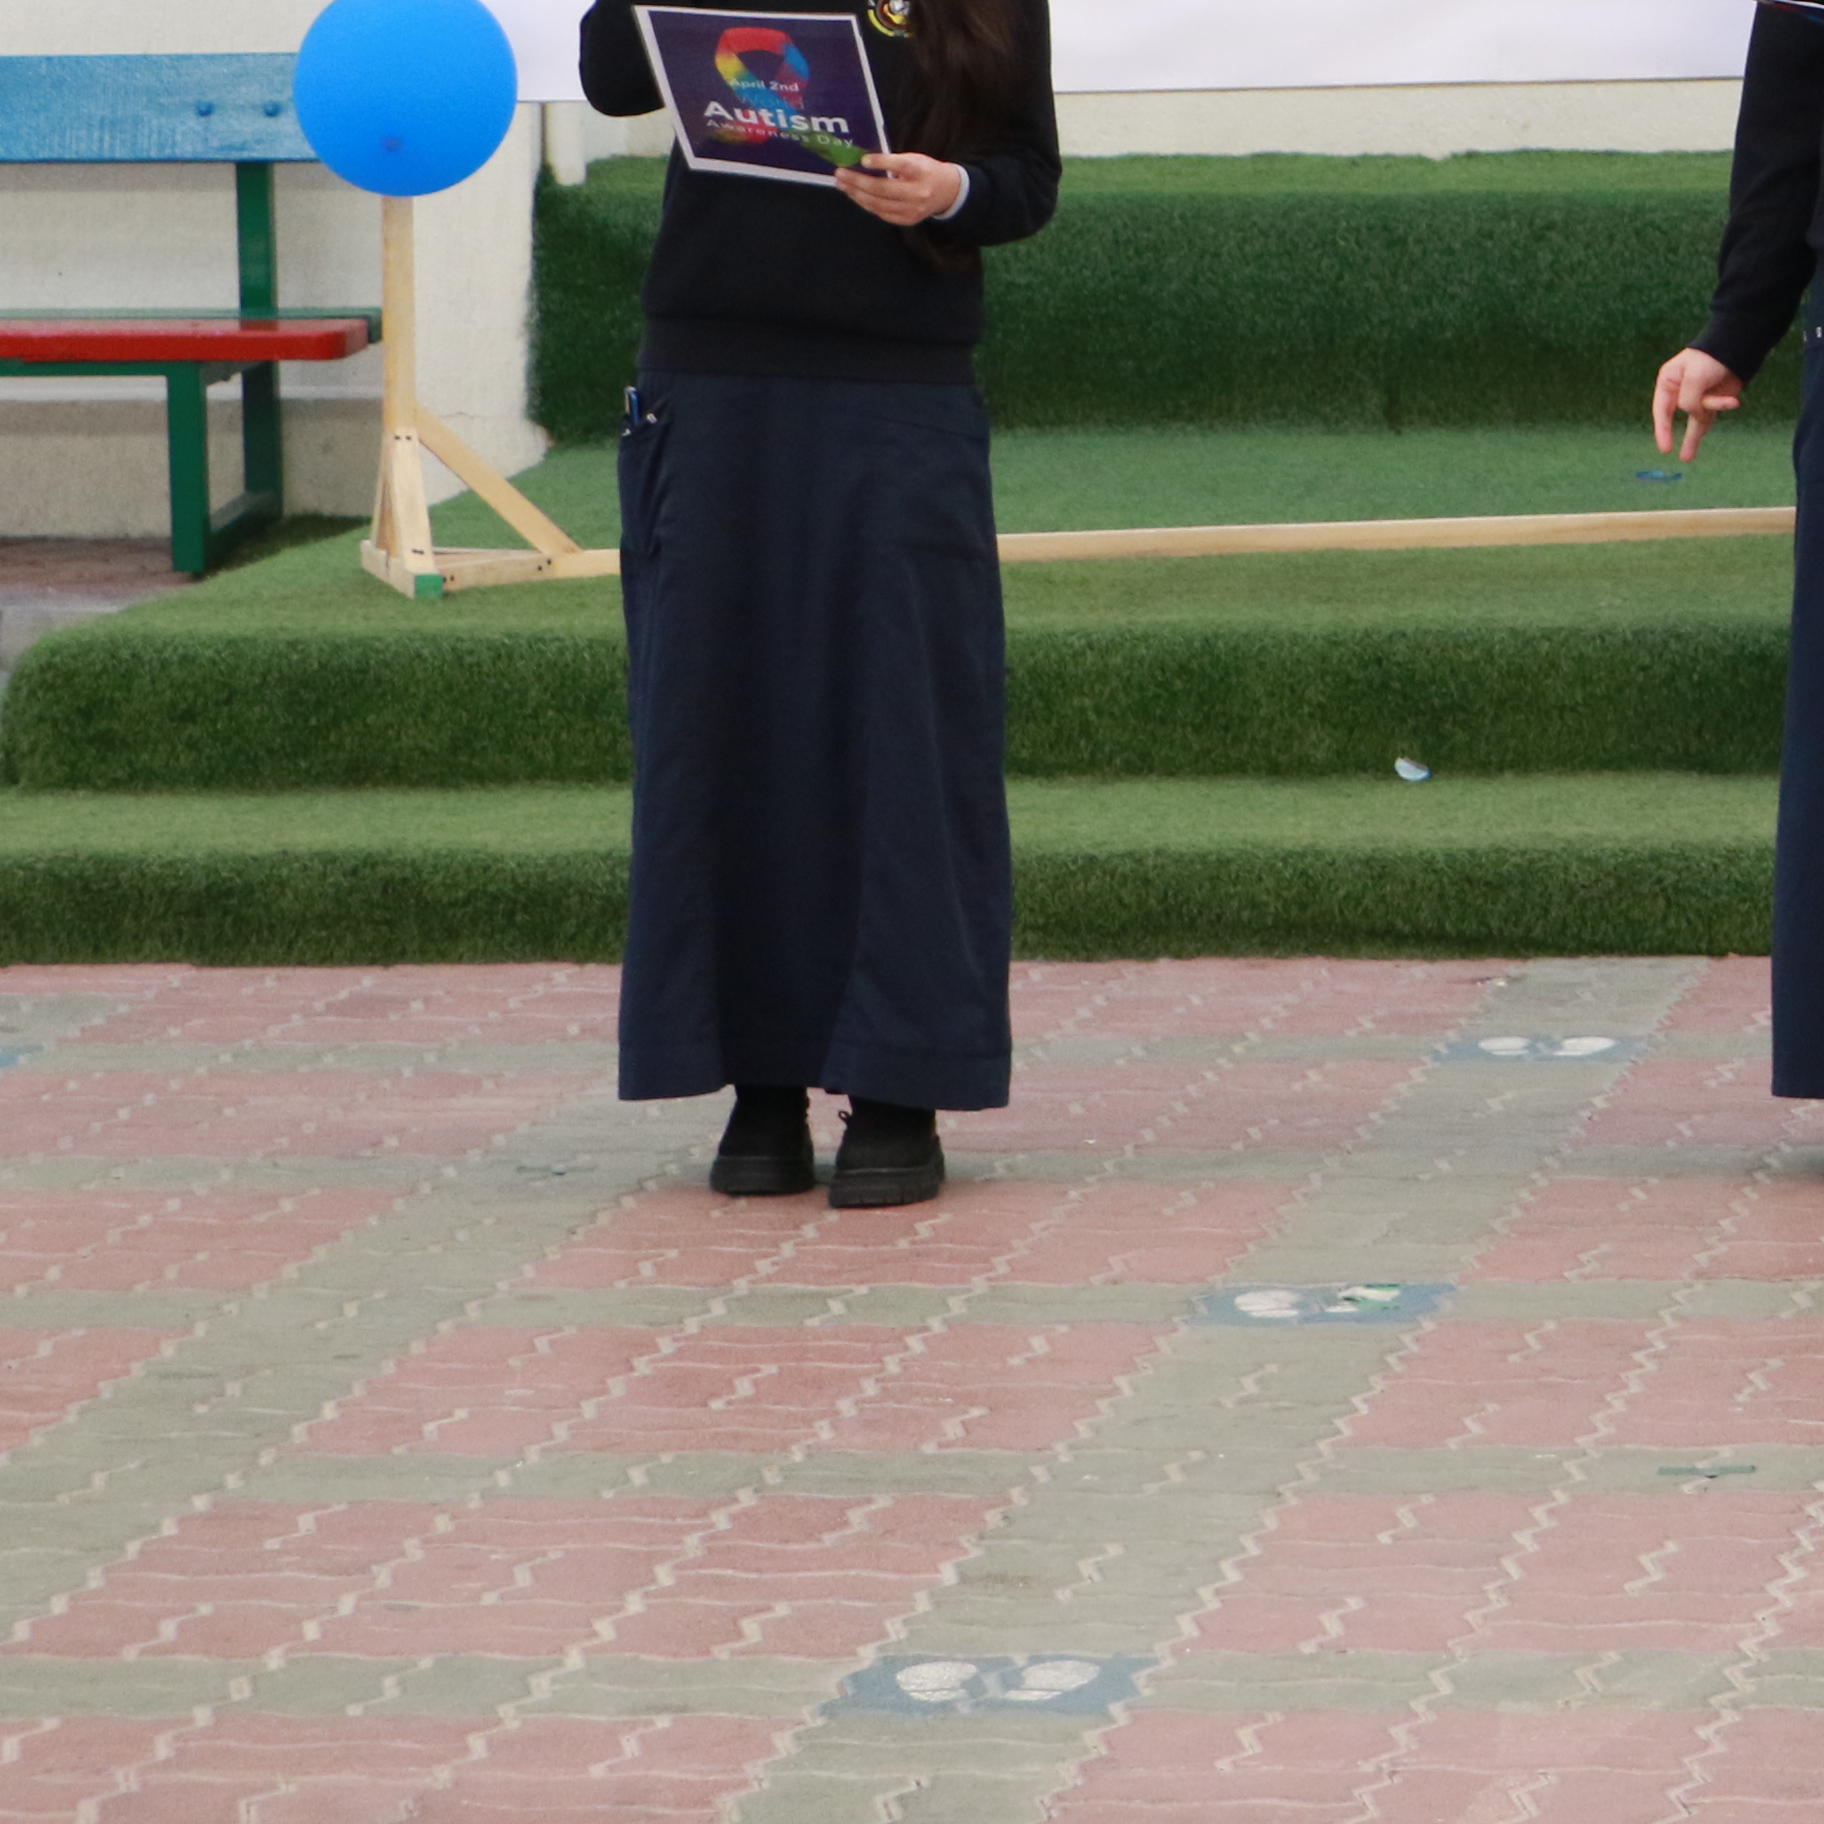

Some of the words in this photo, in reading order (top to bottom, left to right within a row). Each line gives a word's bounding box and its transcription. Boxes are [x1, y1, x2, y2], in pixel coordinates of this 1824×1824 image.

[729, 78, 765, 91] April
[770, 80, 799, 92] 2nd
[703, 101, 849, 133] Autism
[706, 119, 809, 143] Awareness
[815, 131, 854, 148] Day
